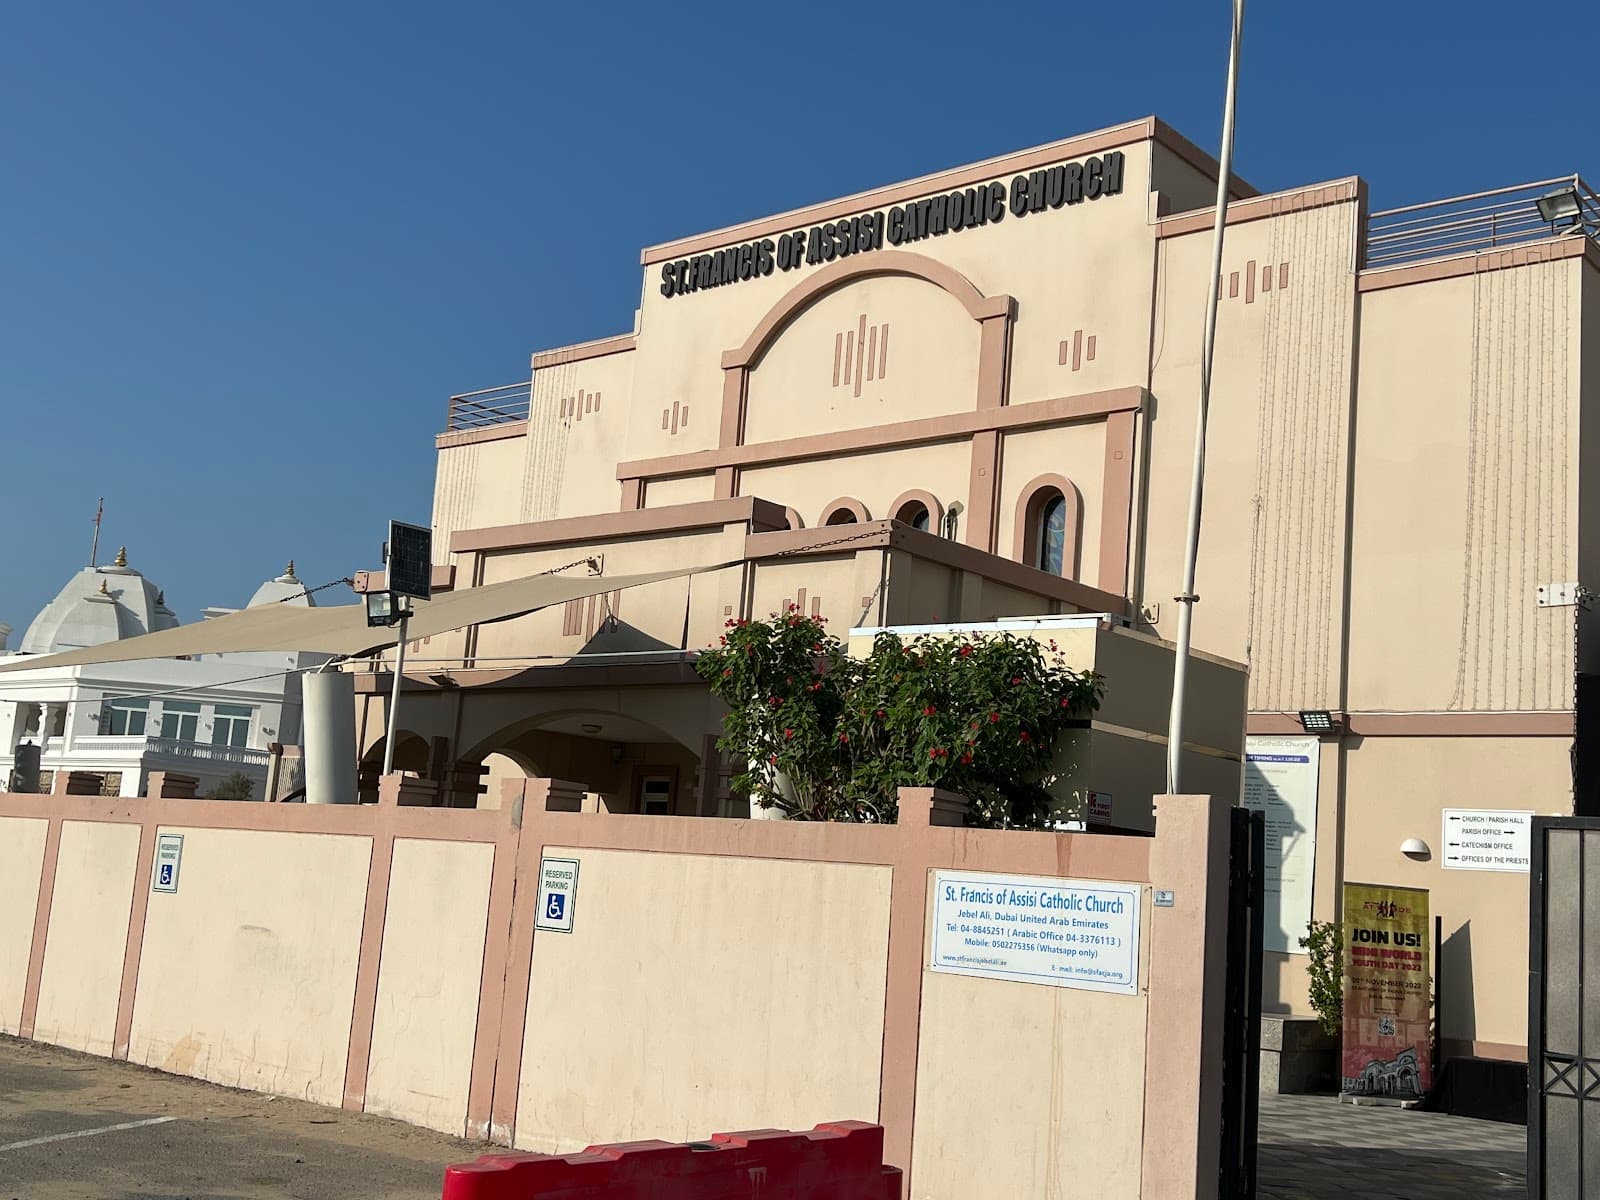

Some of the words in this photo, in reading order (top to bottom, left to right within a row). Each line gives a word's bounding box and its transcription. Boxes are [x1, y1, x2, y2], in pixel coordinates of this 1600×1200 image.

[777, 230, 807, 272] OF
[806, 211, 885, 266] ASSISI
[887, 181, 1007, 246] CATHOLIC
[1009, 151, 1126, 218] CHURCH
[1488, 816, 1509, 824] PARISH
[1461, 841, 1492, 849] CATECHISM
[1493, 842, 1513, 850] OFFICE
[1461, 855, 1484, 863] OFFICES
[1505, 857, 1529, 865] PRIESTS
[545, 869, 573, 880] RESERVED
[545, 880, 568, 890] PARKING
[945, 886, 958, 902] St.
[960, 886, 994, 904] Francis
[996, 888, 1007, 905] of
[1009, 889, 1037, 908] Assisi
[1039, 892, 1083, 911] Catholic
[1085, 895, 1124, 914] Church
[958, 909, 978, 919] Jebel
[979, 911, 992, 921] Ali,
[994, 912, 1018, 922] Dubai
[1020, 914, 1047, 924] United
[1049, 916, 1070, 926] Arab
[1072, 918, 1109, 930] Emirates
[946, 923, 958, 932] Tel:
[960, 924, 1004, 936] 04-8845251
[1012, 929, 1038, 939] Arabic
[1040, 931, 1064, 941] Office
[1065, 933, 1115, 946] 04-3376113
[1352, 928, 1389, 944] JOIN
[1393, 932, 1421, 947] US!
[964, 938, 989, 947] Mobile:
[992, 940, 1035, 951] 0502275356
[1037, 943, 1077, 957] (Whatsapp
[1078, 948, 1098, 959] only)
[1380, 949, 1422, 961] WORLD
[1352, 959, 1380, 969] YOUTH
[1381, 961, 1400, 970] DAY
[1366, 978, 1404, 987] NOVEMBER
